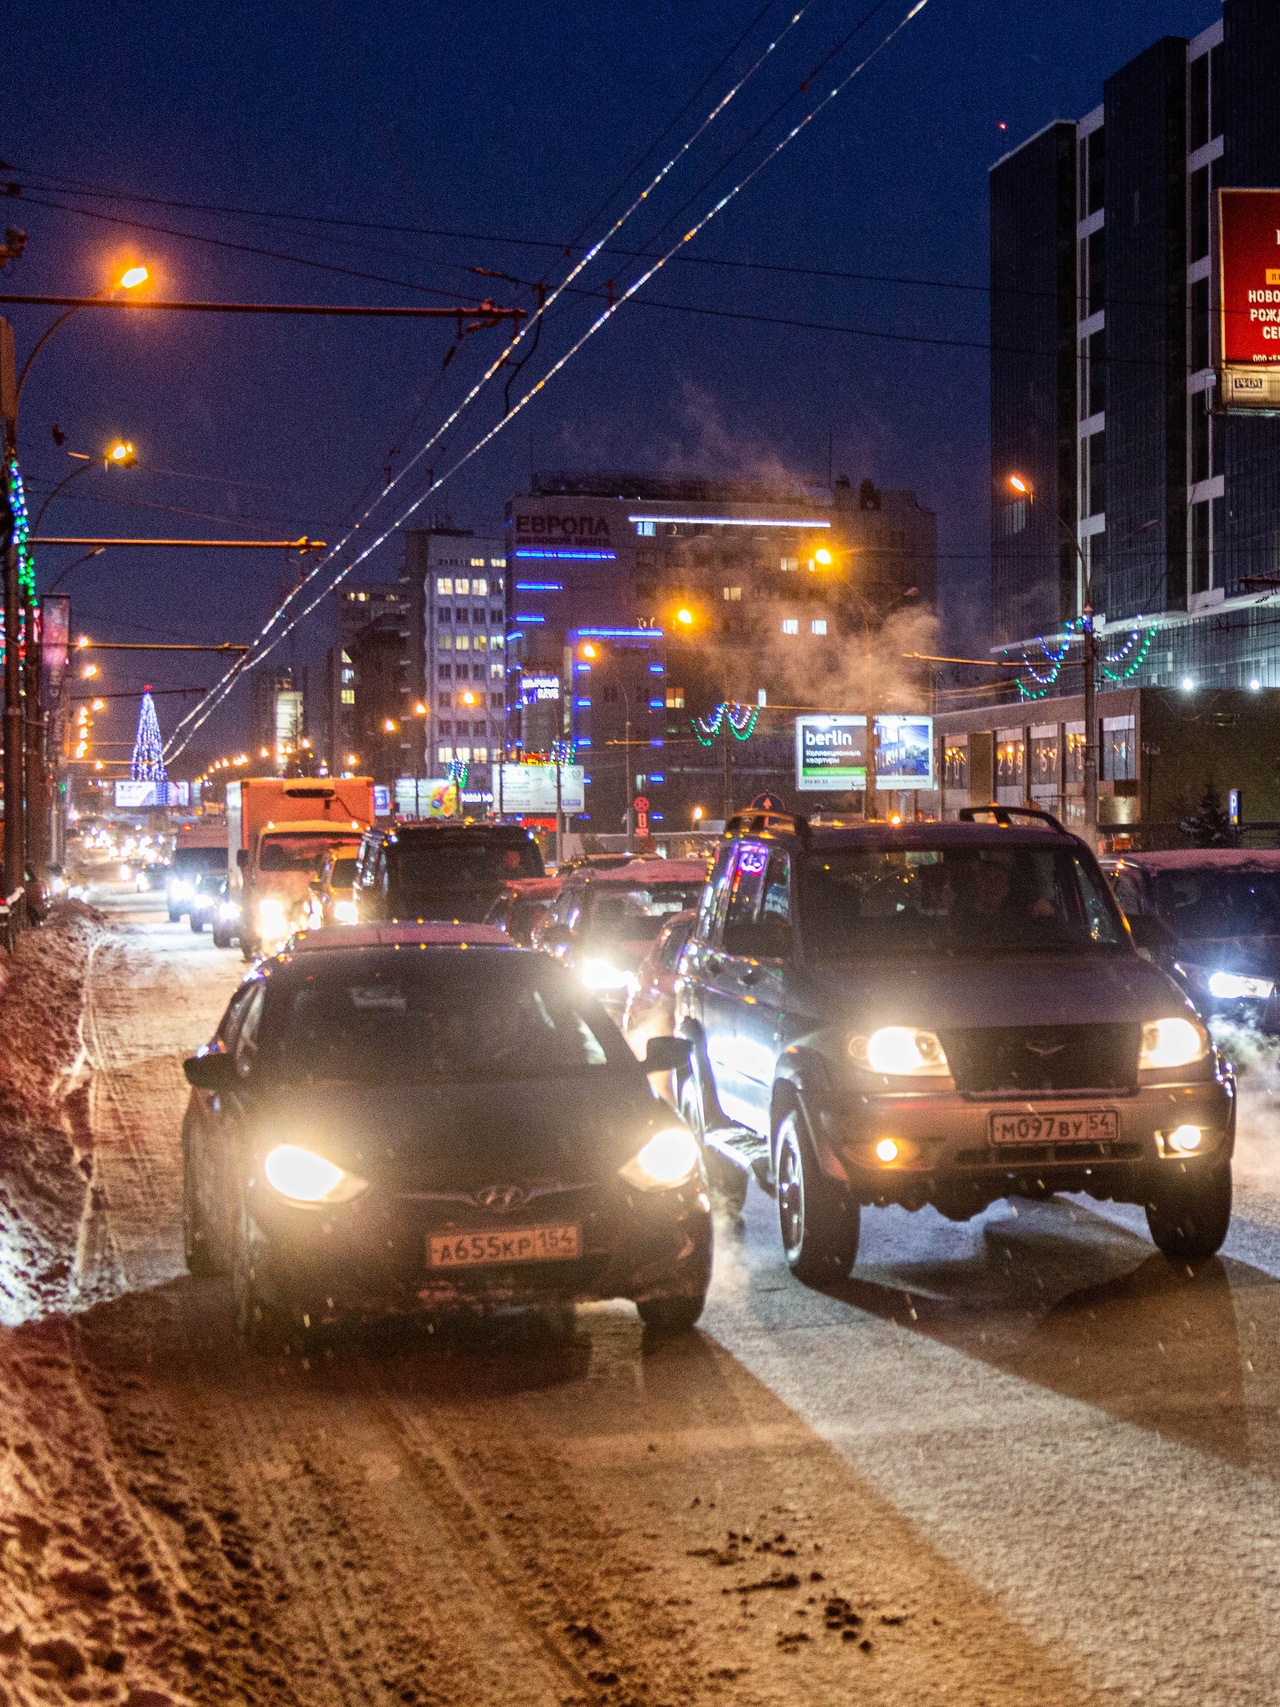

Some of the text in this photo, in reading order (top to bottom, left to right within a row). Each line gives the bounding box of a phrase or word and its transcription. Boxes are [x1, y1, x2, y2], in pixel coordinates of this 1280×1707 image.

[515, 516, 610, 535] ЕВРОПА
[805, 730, 853, 746] berlin
[1230, 794, 1237, 814] P
[1089, 1114, 1109, 1130] 54
[538, 1230, 573, 1249] 154
